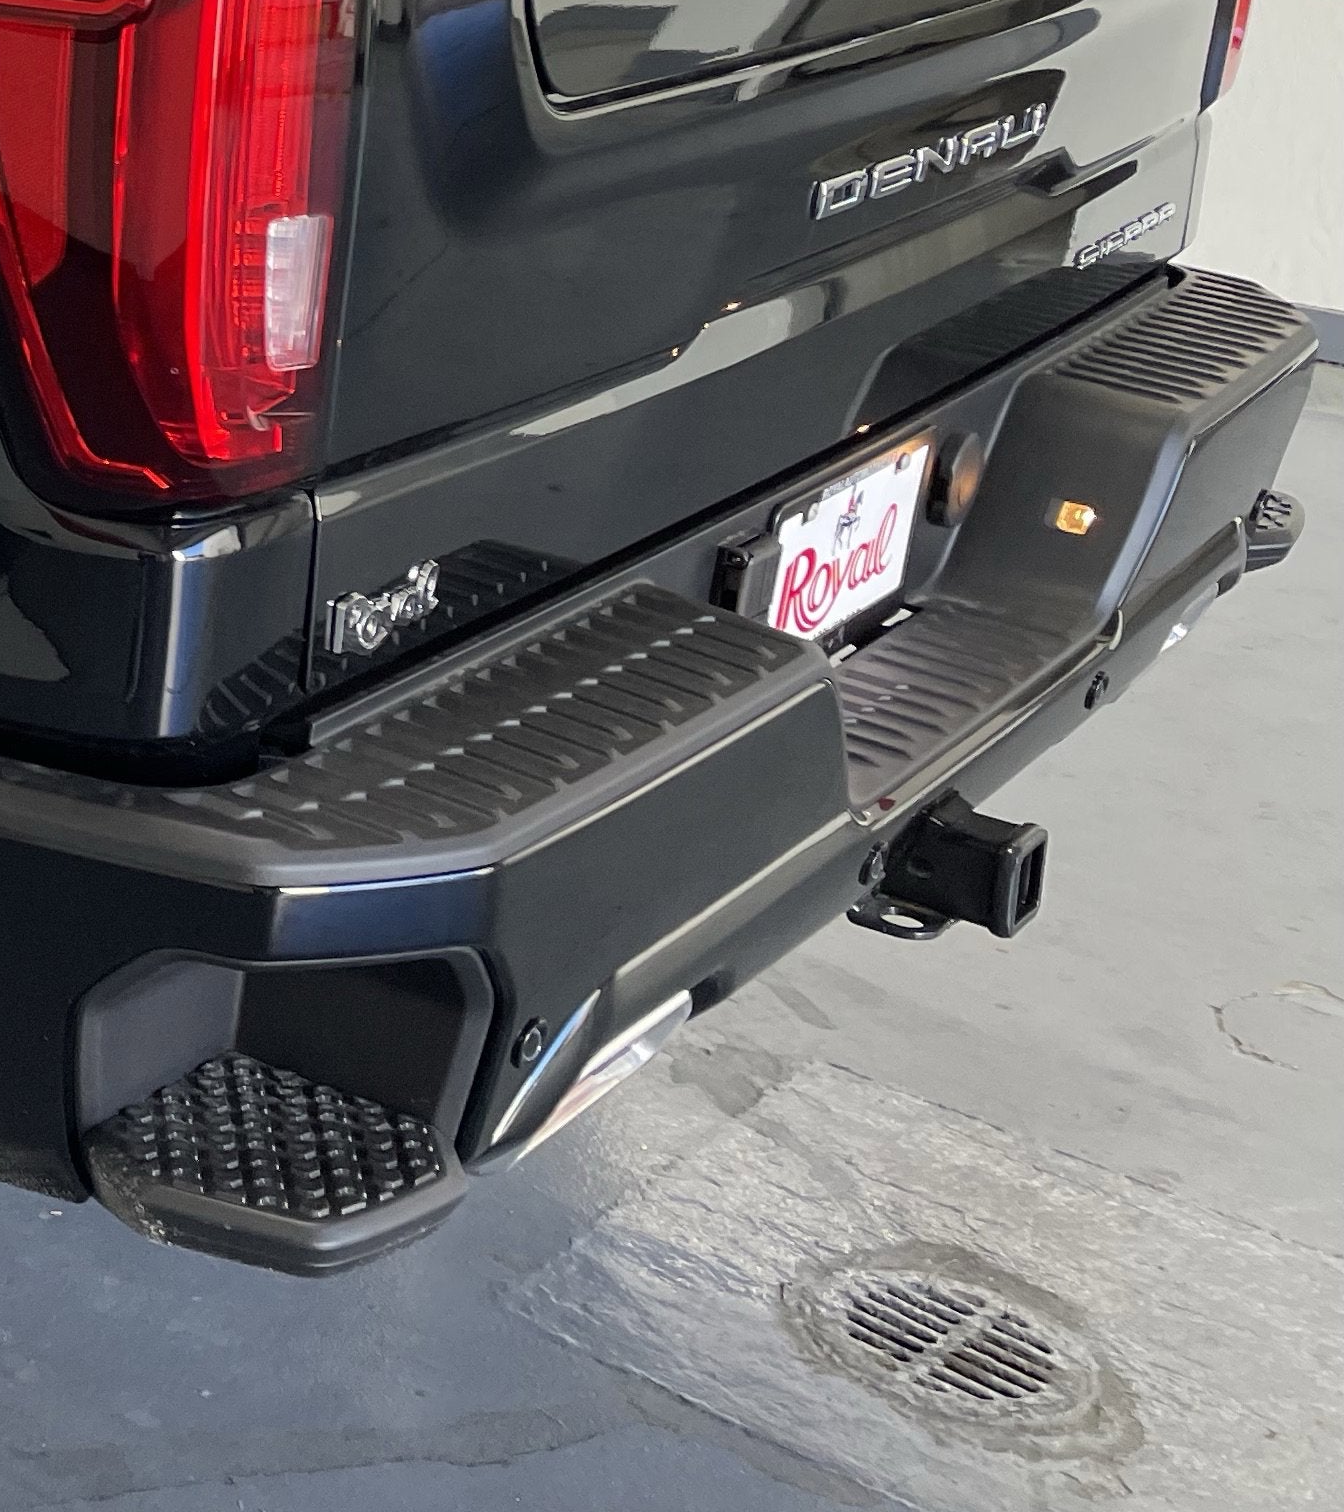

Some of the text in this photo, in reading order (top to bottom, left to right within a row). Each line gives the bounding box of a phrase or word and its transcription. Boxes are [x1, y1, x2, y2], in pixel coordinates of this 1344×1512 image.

[811, 102, 1048, 221] DENALI
[1073, 202, 1176, 270] SIERRA
[775, 503, 898, 633] Royal
